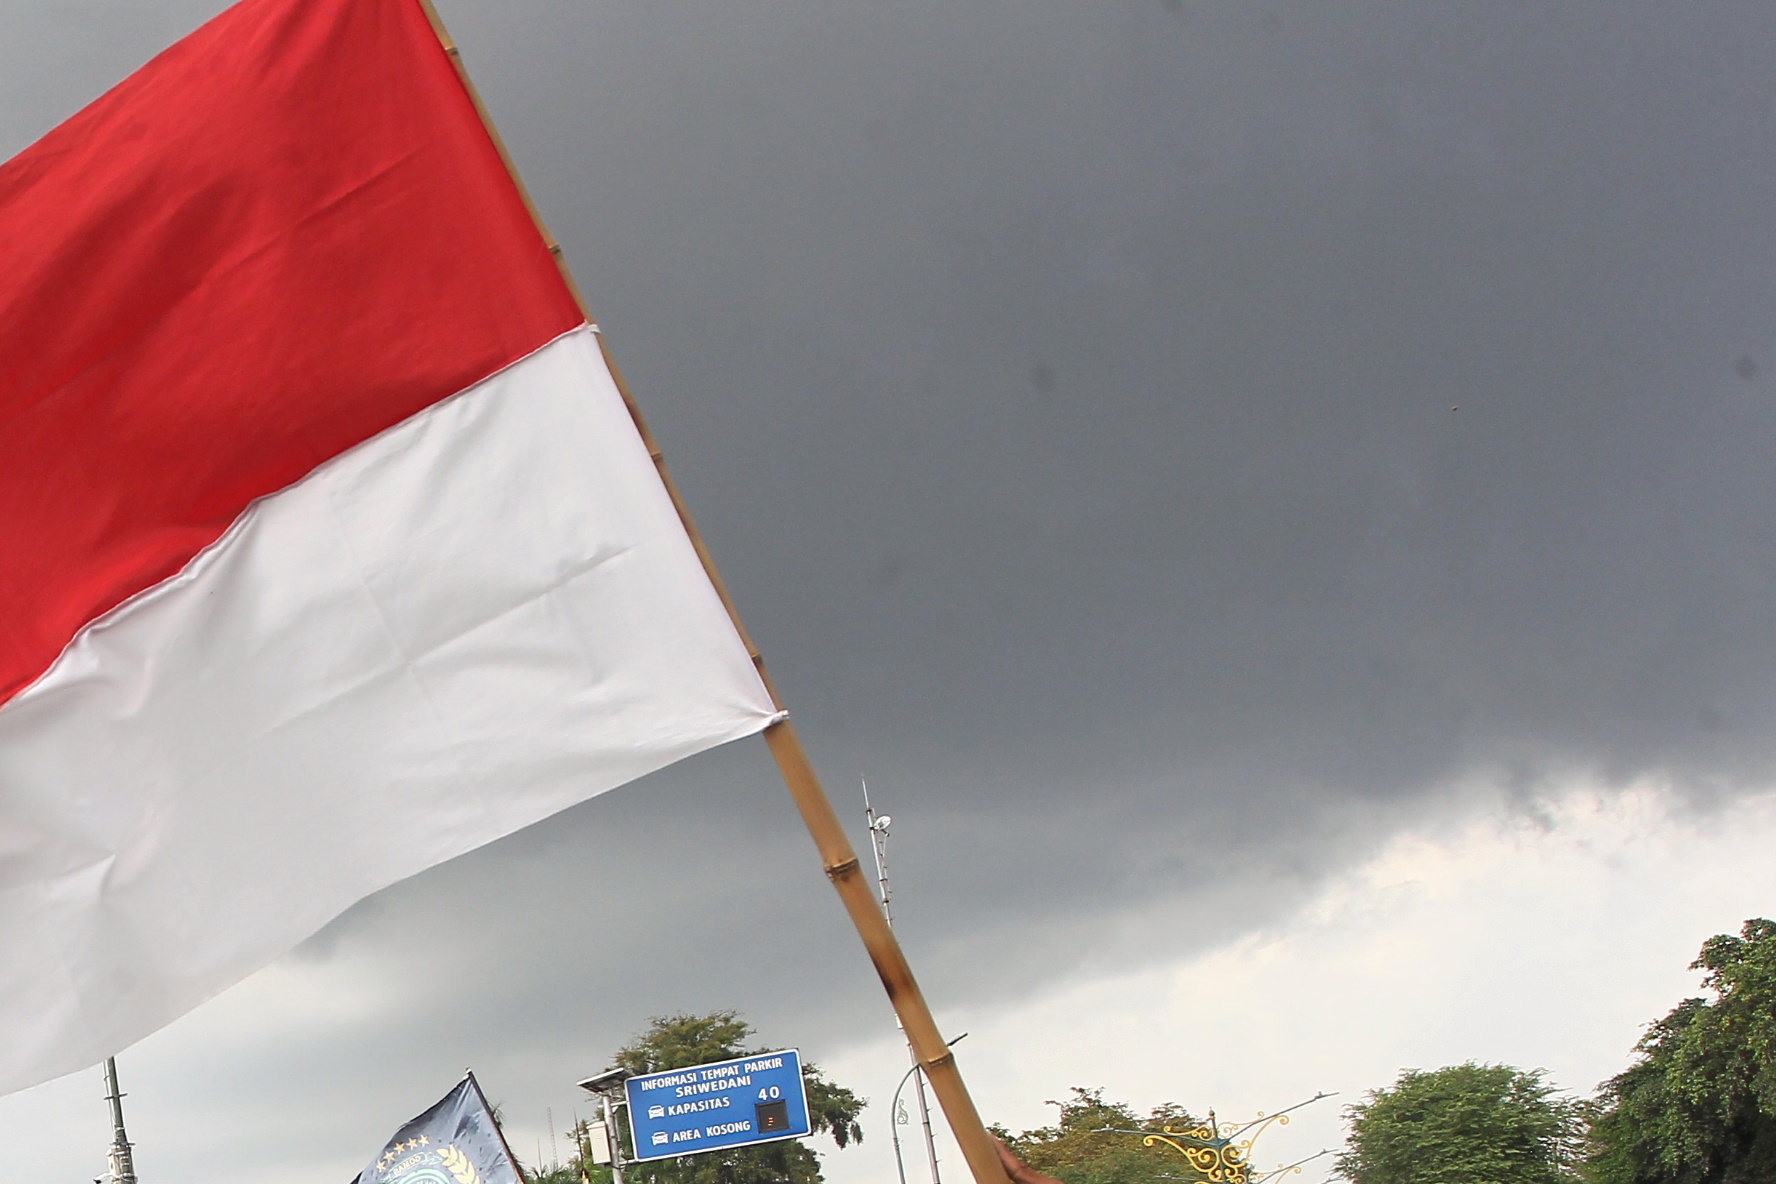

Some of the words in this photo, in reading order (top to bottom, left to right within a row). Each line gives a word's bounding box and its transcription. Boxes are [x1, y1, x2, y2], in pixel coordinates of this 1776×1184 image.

[641, 1072, 697, 1091] INFORMASI
[701, 1064, 740, 1080] TEMPAT
[745, 1057, 783, 1073] PARKIR
[676, 1076, 751, 1098] SRIWEDANI
[668, 1097, 730, 1116] KAPASITAS
[758, 1086, 780, 1101] 40
[672, 1129, 701, 1143] AREA
[706, 1120, 751, 1137] KOSONG
